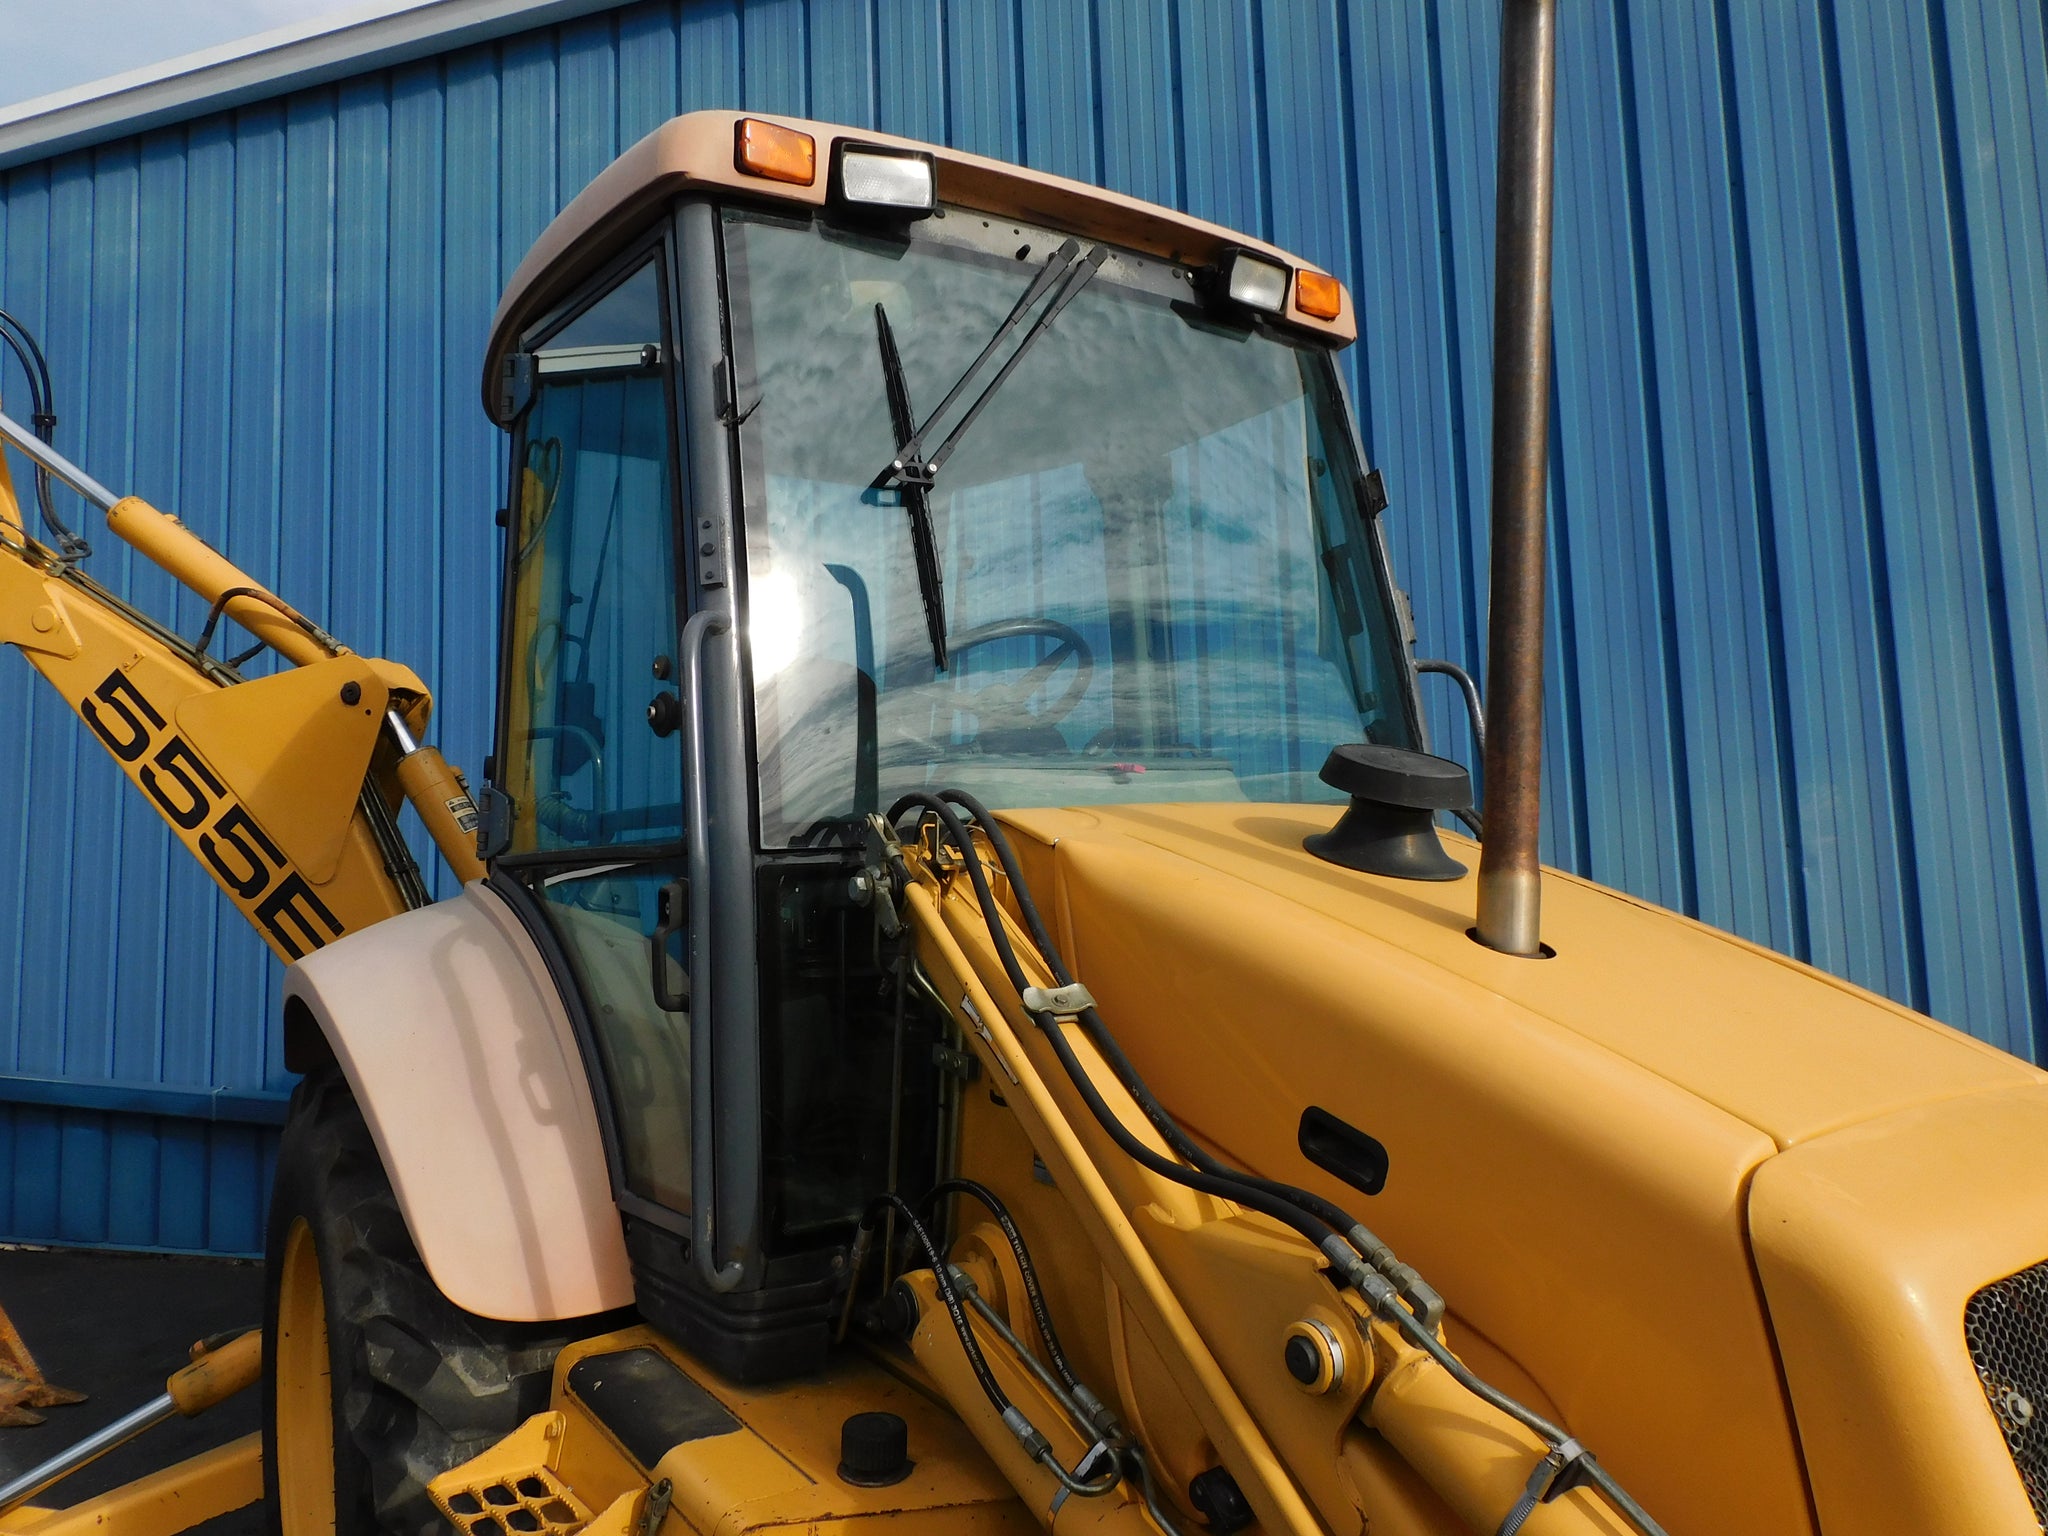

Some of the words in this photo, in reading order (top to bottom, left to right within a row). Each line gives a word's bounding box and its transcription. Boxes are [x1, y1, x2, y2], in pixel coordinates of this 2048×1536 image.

[80, 668, 346, 961] 555E
[1013, 1238, 1028, 1269] TOUGH
[1024, 1270, 1038, 1297] COVER
